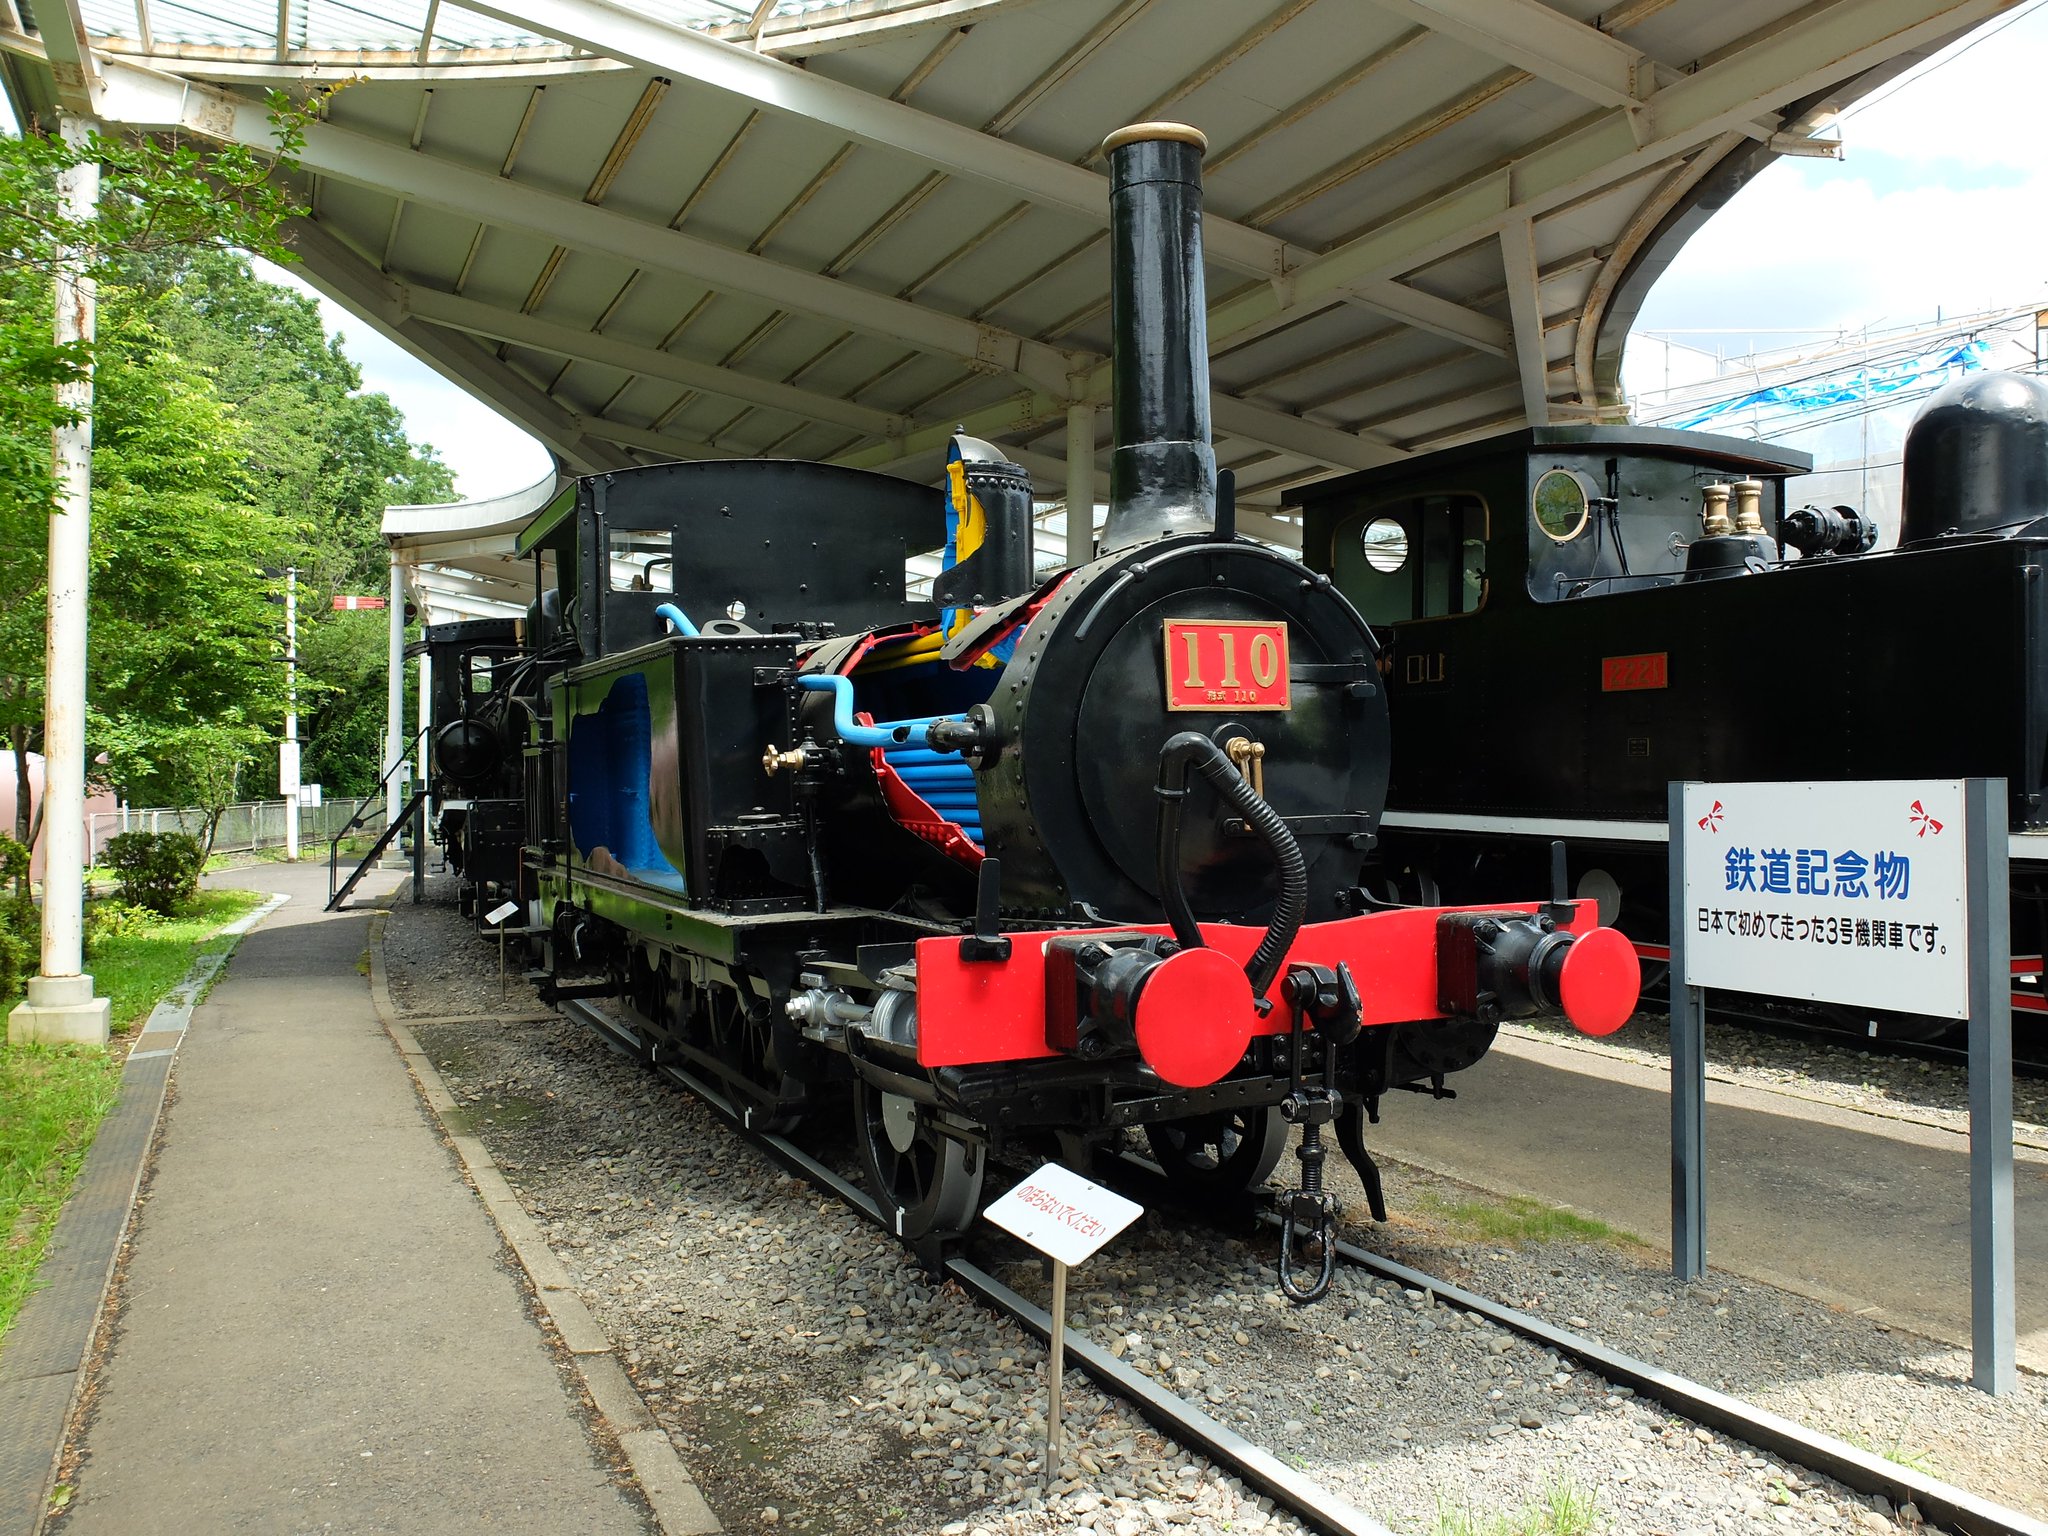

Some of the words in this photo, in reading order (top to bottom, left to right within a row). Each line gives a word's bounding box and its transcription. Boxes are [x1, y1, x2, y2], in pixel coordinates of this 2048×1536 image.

[1182, 632, 1278, 688] 110
[1609, 656, 1659, 686] 2221
[1234, 690, 1257, 702] 110
[1724, 846, 1911, 901] 鉄道記念物
[1698, 907, 1947, 956] 日本で初めて走った3号機関車です。
[1016, 1185, 1107, 1237] のぼらないでください
